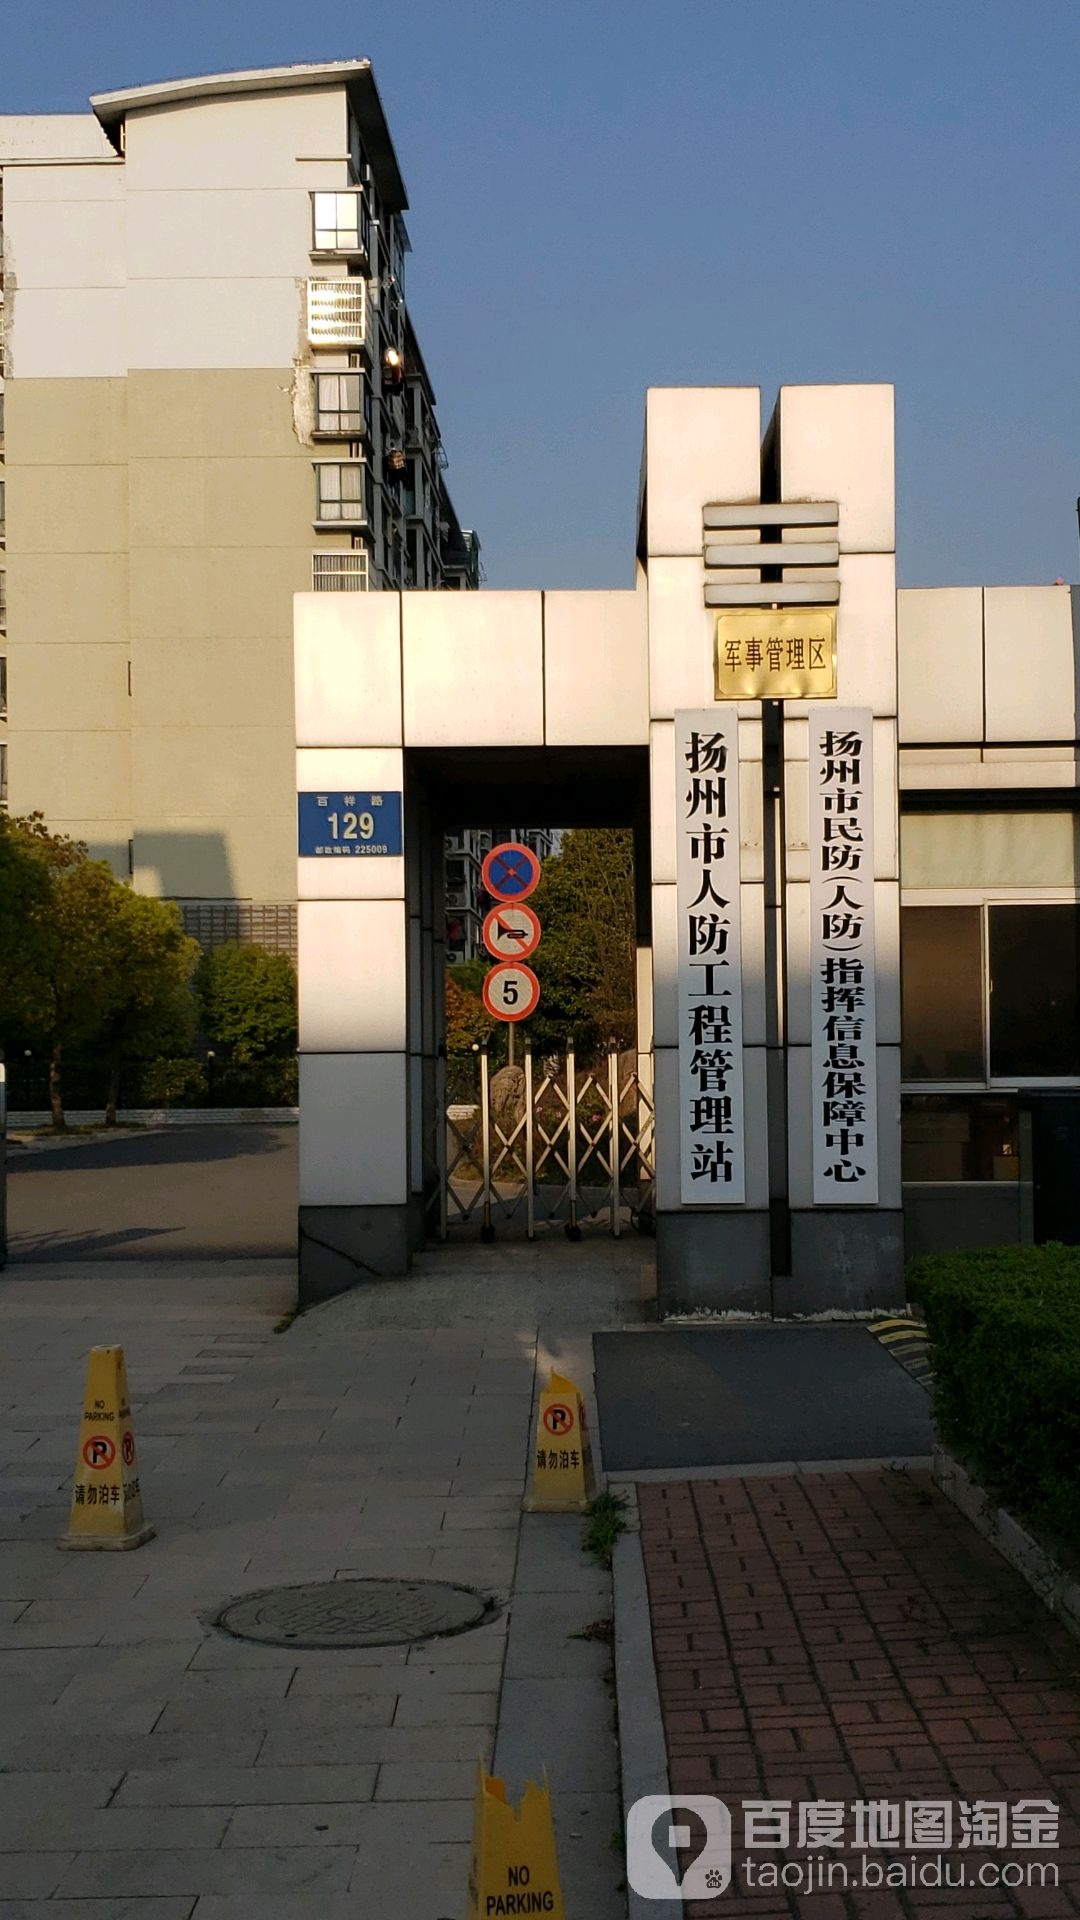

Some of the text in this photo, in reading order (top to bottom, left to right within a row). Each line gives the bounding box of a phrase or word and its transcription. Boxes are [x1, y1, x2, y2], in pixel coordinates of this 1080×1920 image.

[724, 636, 826, 672] 军事管理区
[328, 812, 374, 840] 129
[354, 844, 388, 854] 225009
[685, 731, 733, 1184] 扬州市人防工程管理站
[502, 980, 518, 1005] 5
[94, 1400, 105, 1409] NO
[84, 1411, 115, 1422] PARKING
[537, 1449, 580, 1470] 请勿泊车
[75, 1484, 121, 1505] 请勿泊车
[508, 1865, 530, 1887] NO
[486, 1890, 555, 1917] PARKING
